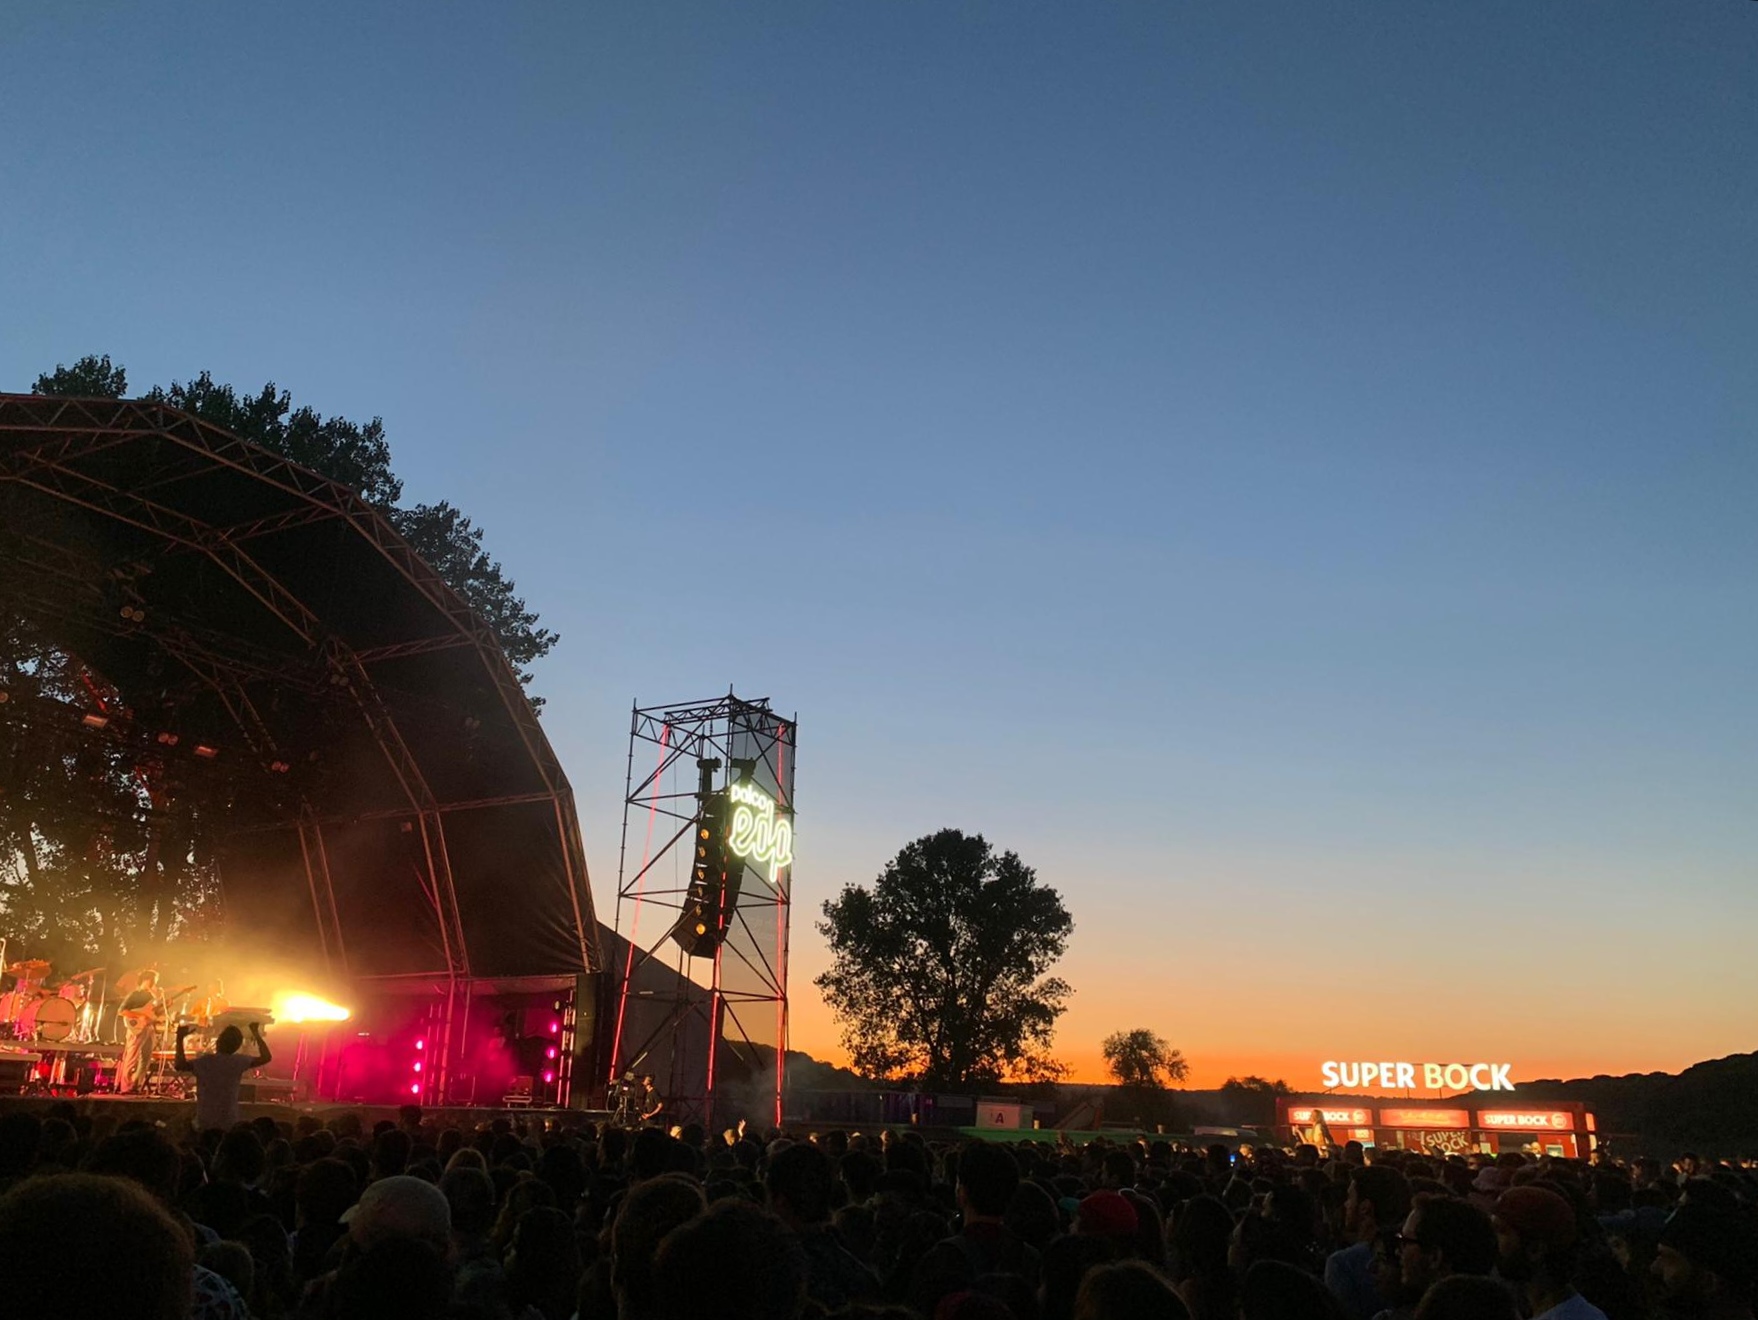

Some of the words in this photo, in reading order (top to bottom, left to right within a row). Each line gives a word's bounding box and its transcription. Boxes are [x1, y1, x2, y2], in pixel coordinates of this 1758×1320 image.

[729, 800, 793, 883] edp
[1321, 1061, 1416, 1088] SUPER
[1423, 1063, 1516, 1091] BOCK
[1293, 1111, 1312, 1121] SUP
[1484, 1114, 1517, 1125] SUPER
[1517, 1115, 1549, 1126] BOCK
[1441, 1134, 1469, 1152] OCK
